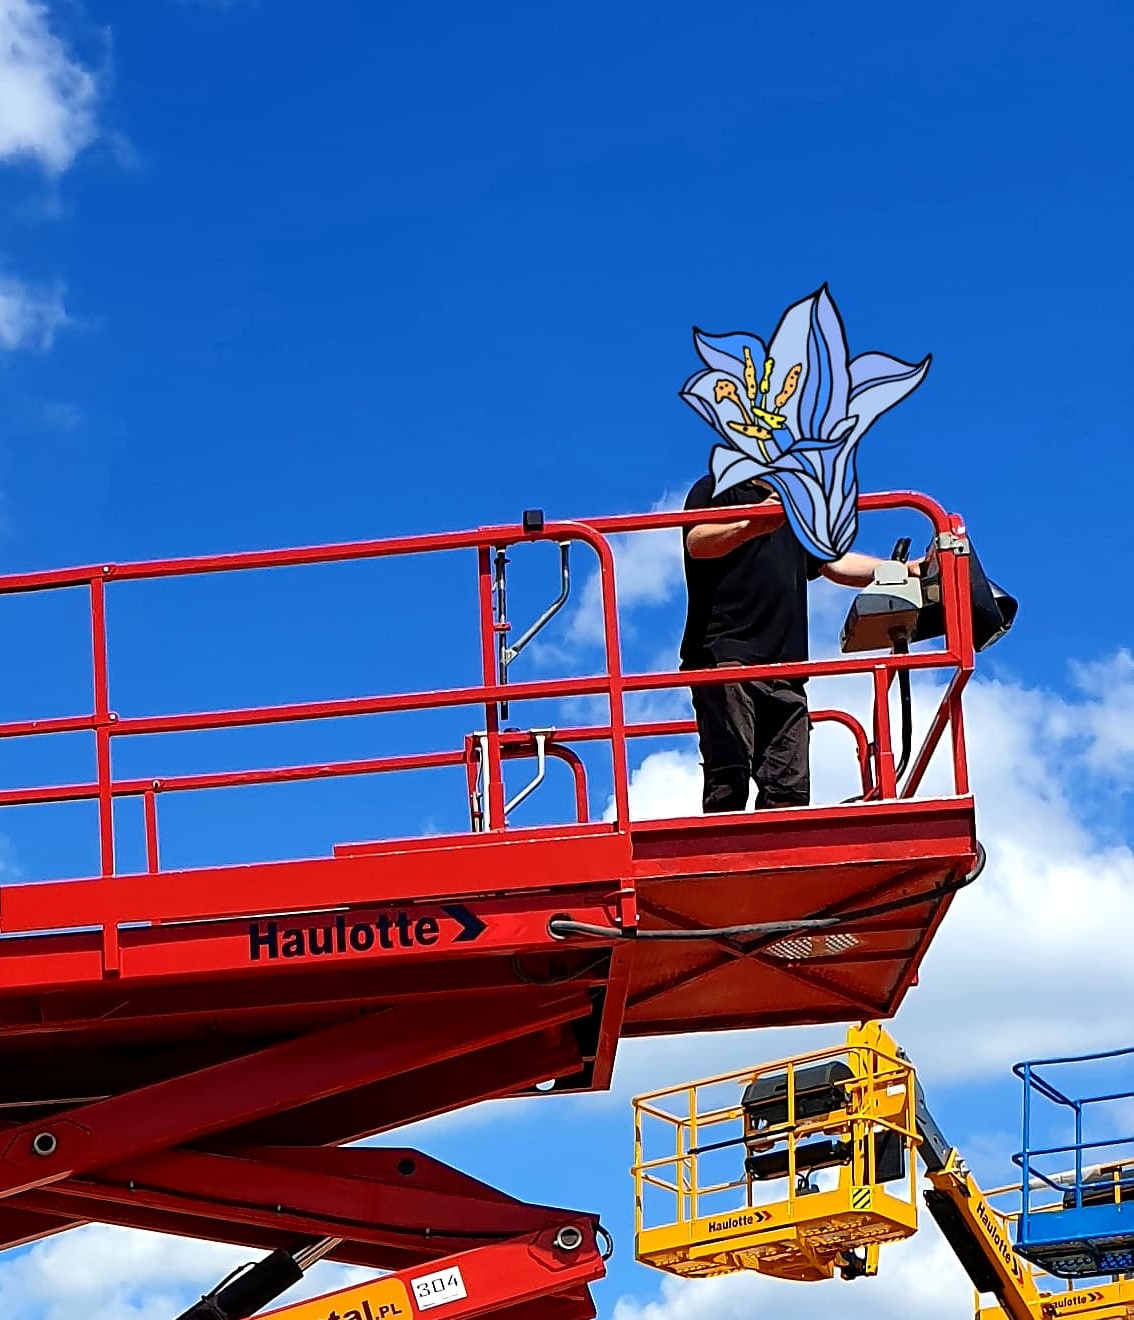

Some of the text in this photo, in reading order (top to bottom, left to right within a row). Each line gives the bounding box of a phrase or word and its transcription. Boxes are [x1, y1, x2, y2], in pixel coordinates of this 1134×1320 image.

[248, 911, 440, 960] Haulotte
[709, 1216, 753, 1232] Haulotte
[976, 1202, 1011, 1264] Haulotte
[417, 1274, 458, 1297] 304
